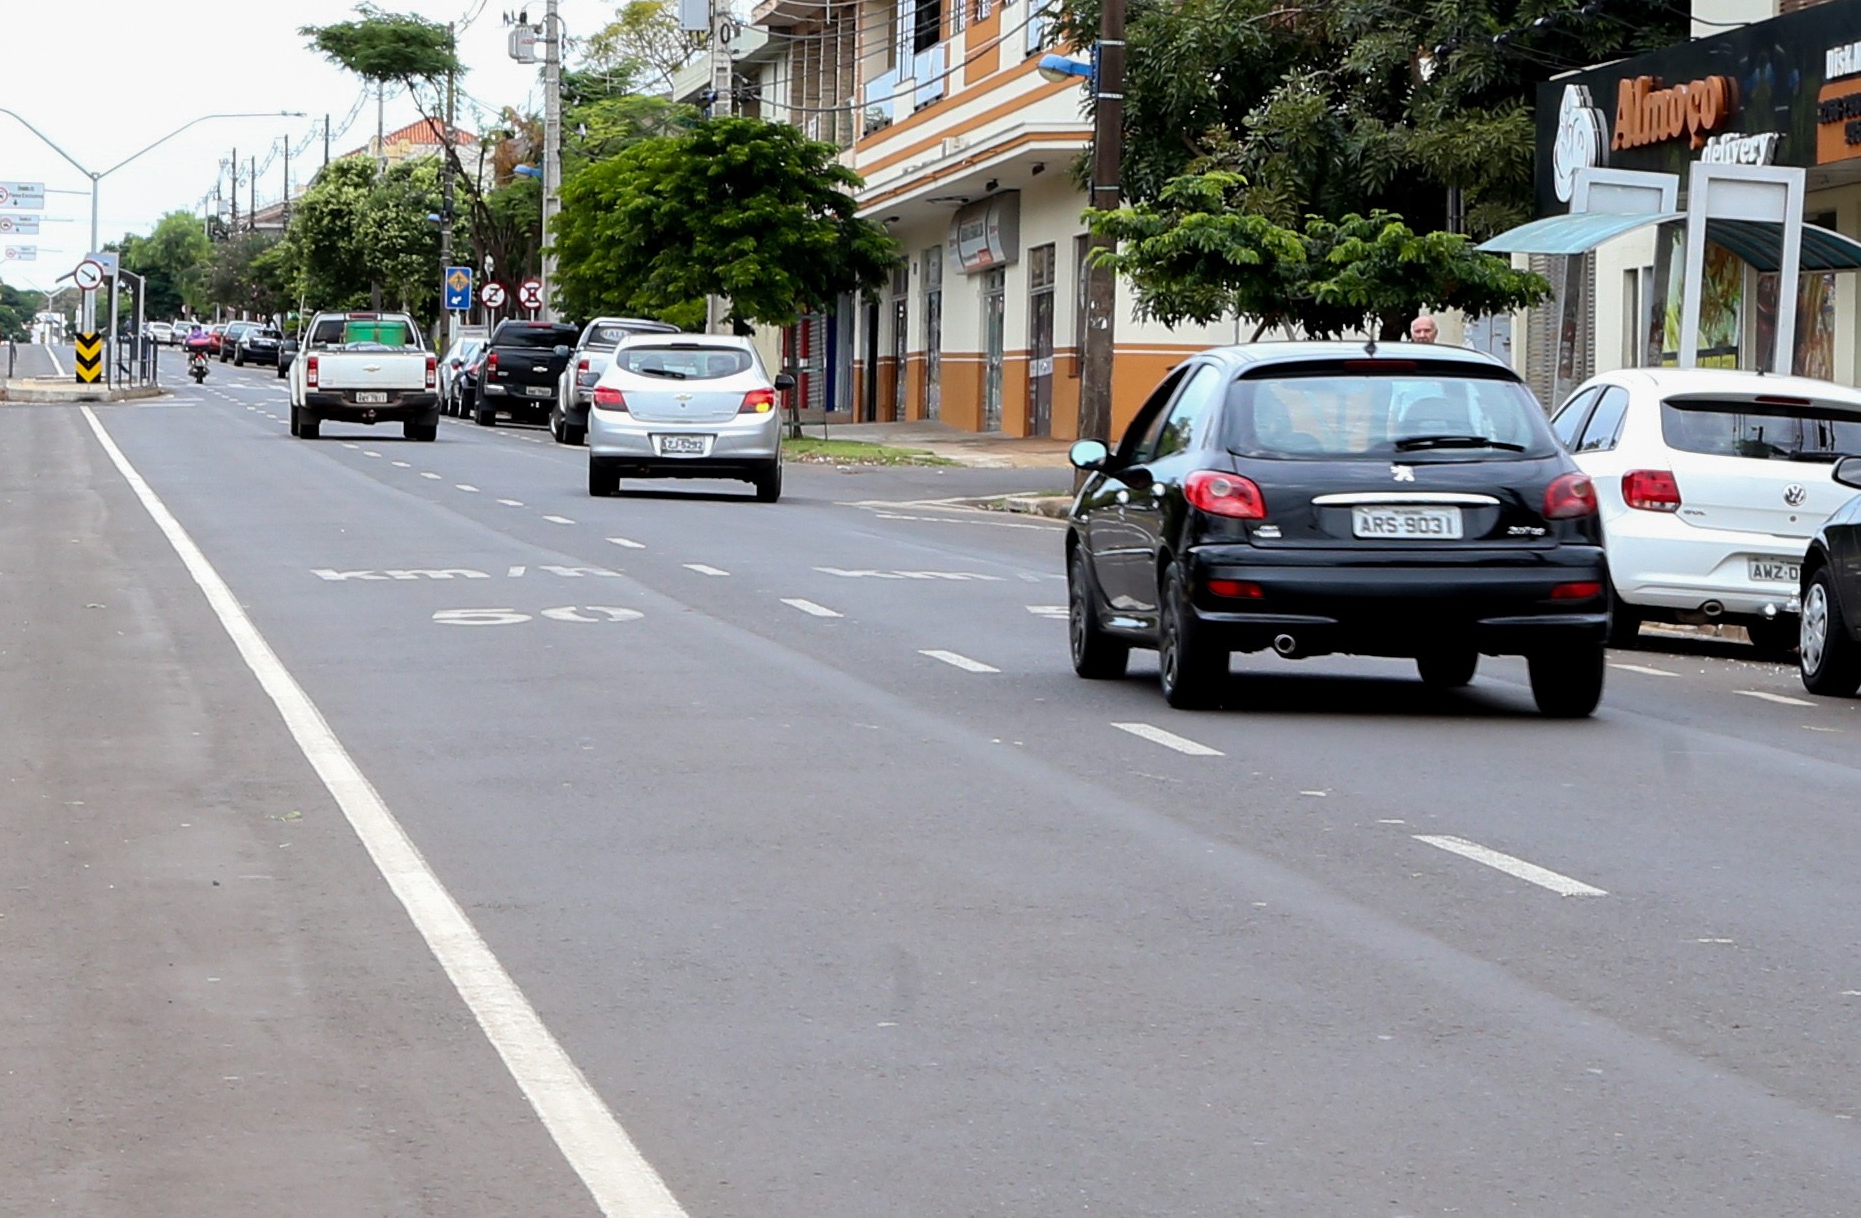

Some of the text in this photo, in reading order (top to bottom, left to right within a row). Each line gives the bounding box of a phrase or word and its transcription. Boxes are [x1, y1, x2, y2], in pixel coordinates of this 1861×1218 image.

[1611, 75, 1722, 151] Almoço
[1701, 132, 1776, 166] delivery
[1360, 516, 1453, 536] ARS-9031
[431, 605, 645, 626] 50
